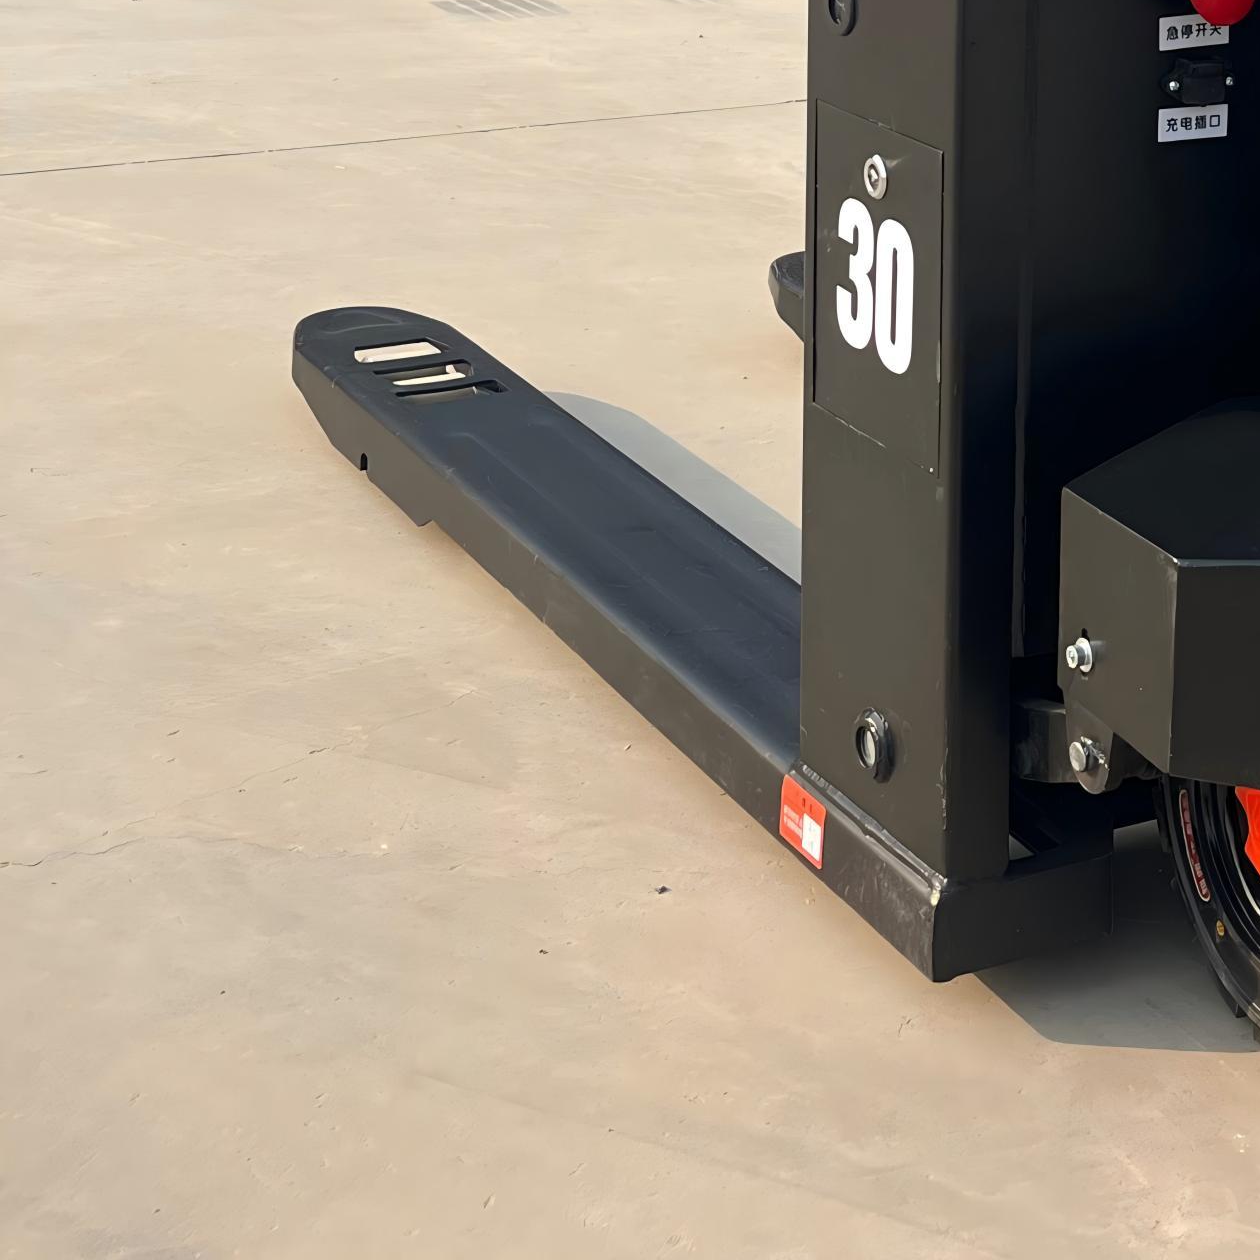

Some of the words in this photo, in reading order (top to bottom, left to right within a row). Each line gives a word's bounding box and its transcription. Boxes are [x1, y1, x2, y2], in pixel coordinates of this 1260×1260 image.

[1165, 113, 1221, 133] 充电插口
[836, 197, 914, 375] 30
